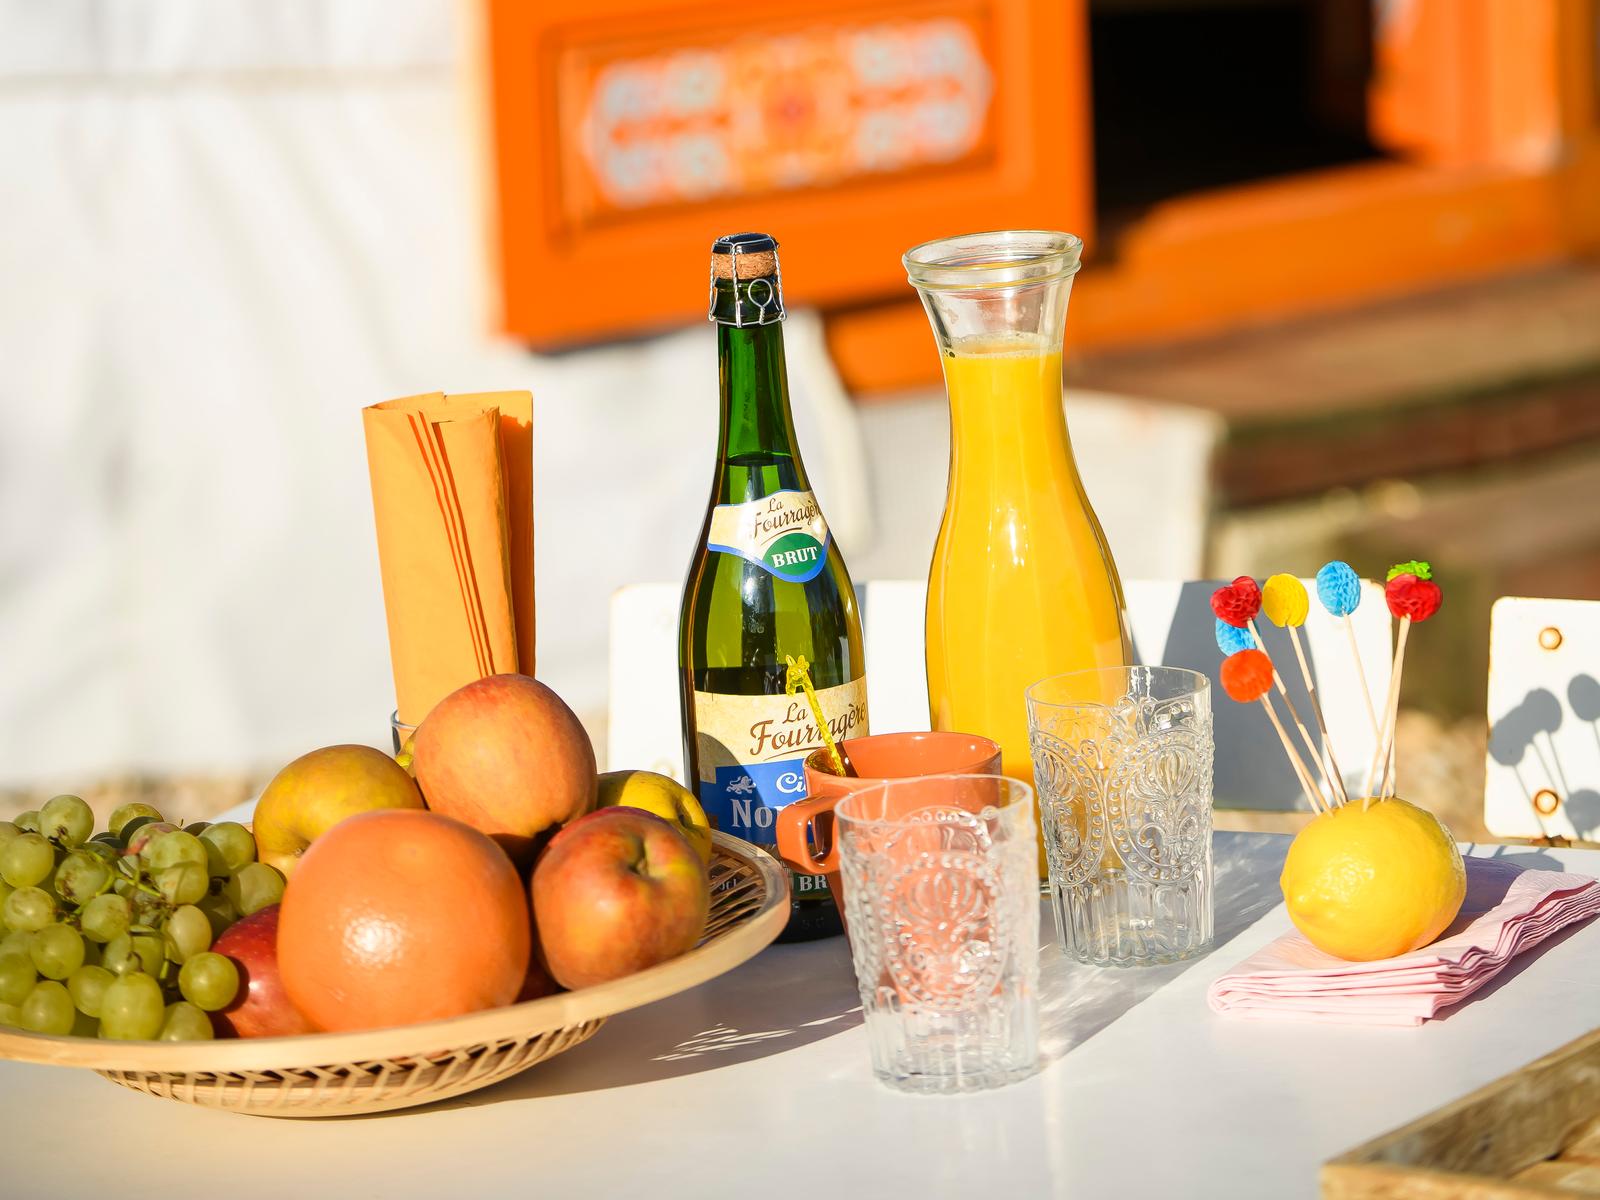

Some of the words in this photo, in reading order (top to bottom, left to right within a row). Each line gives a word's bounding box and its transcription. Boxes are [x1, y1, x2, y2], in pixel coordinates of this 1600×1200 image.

[767, 497, 784, 514] La
[771, 546, 818, 568] BRUT
[782, 702, 808, 724] La
[775, 772, 806, 794] Ci
[729, 798, 784, 828] No
[798, 874, 828, 892] BR
